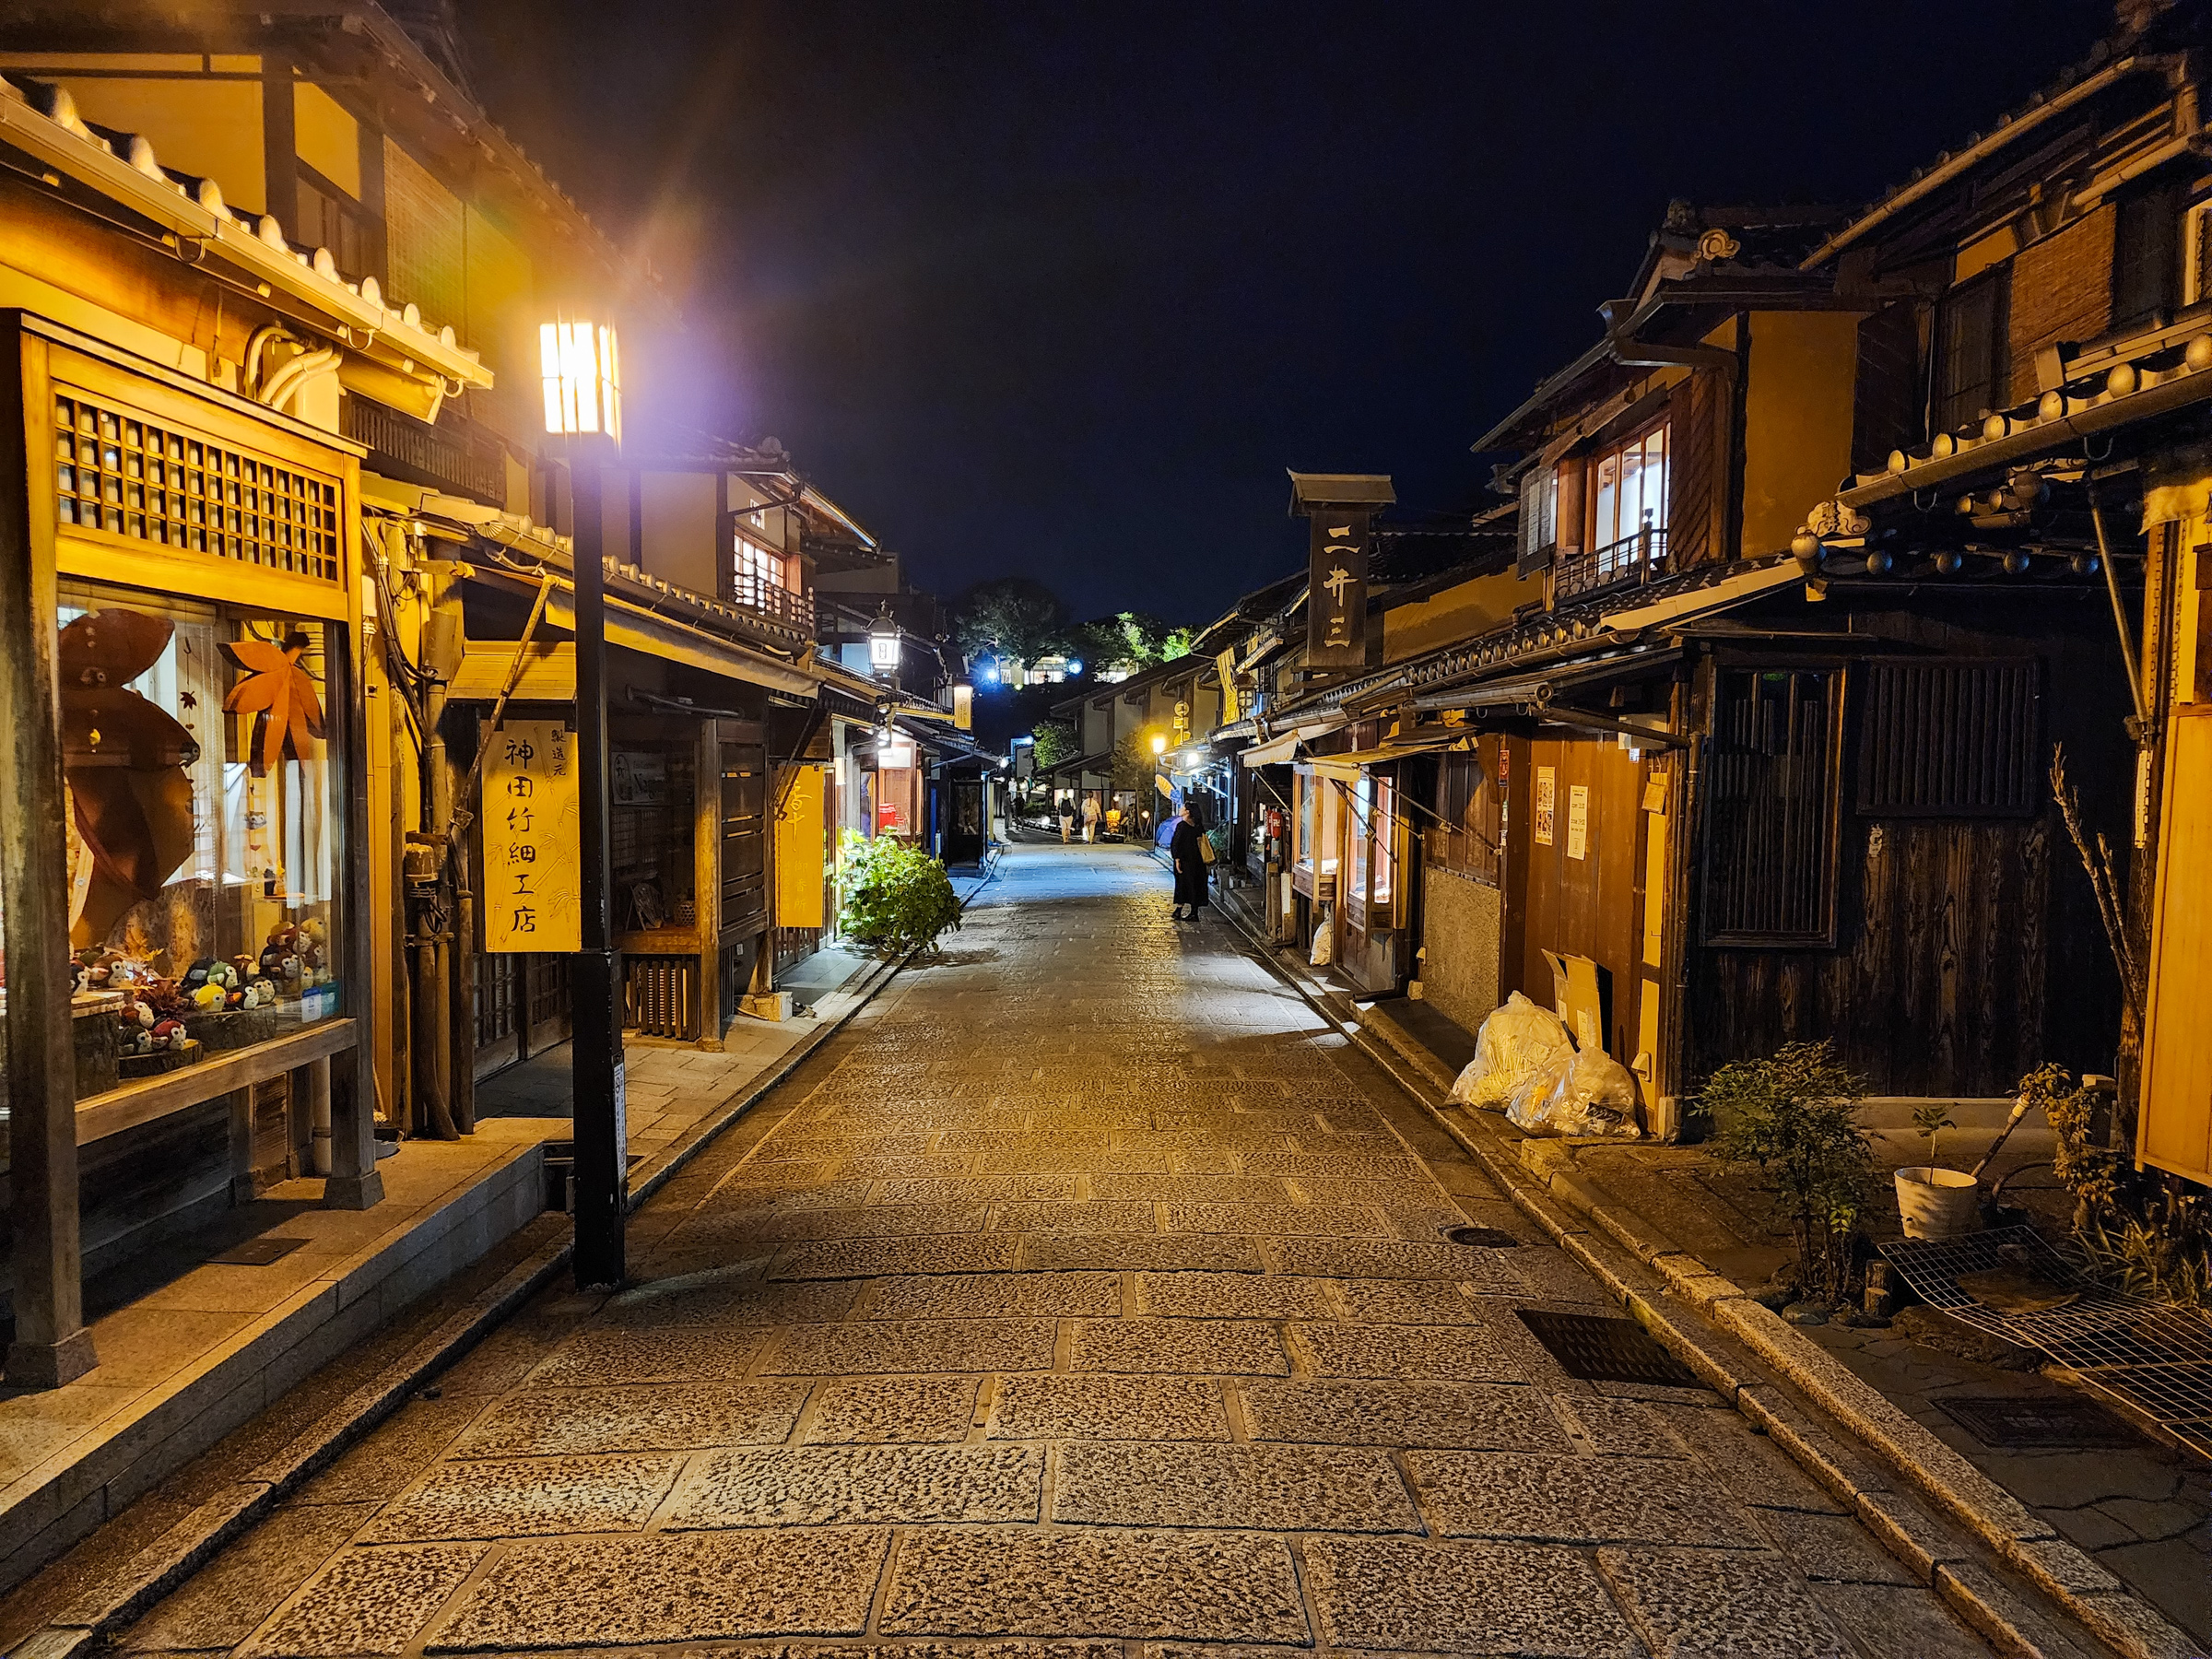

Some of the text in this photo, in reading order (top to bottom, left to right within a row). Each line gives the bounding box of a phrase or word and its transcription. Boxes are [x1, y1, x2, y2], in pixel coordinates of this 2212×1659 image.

[550, 728, 567, 776] 製造元
[504, 739, 536, 933] 神田竹細工店
